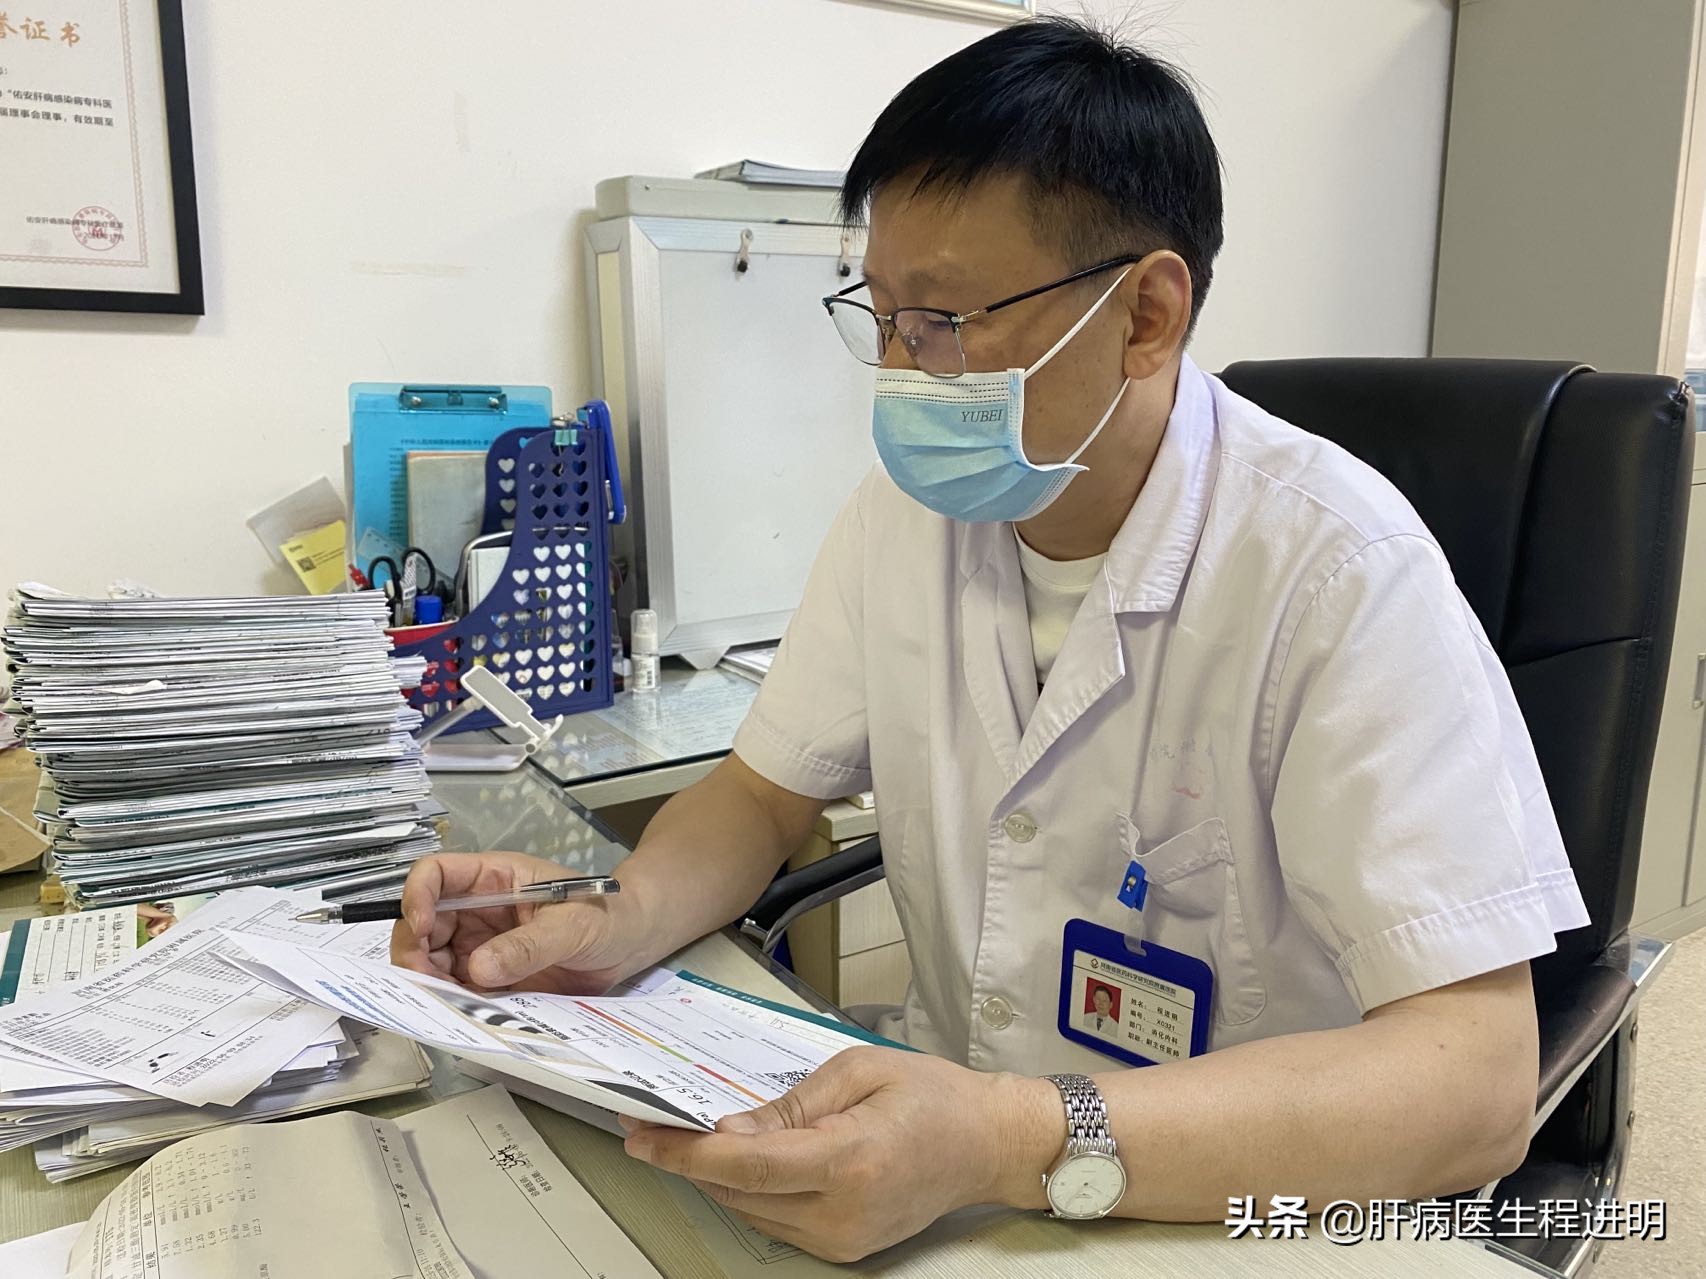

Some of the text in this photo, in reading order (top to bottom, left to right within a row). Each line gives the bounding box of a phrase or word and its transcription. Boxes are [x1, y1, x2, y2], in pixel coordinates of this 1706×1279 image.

[961, 409, 1003, 422] YUBEI
[1156, 1006, 1178, 1022] 程进明
[1151, 1027, 1178, 1045] 消化内科
[1146, 1037, 1179, 1058] 副主任医师
[677, 1088, 712, 1105] 16.5
[145, 1251, 156, 1268] 结果
